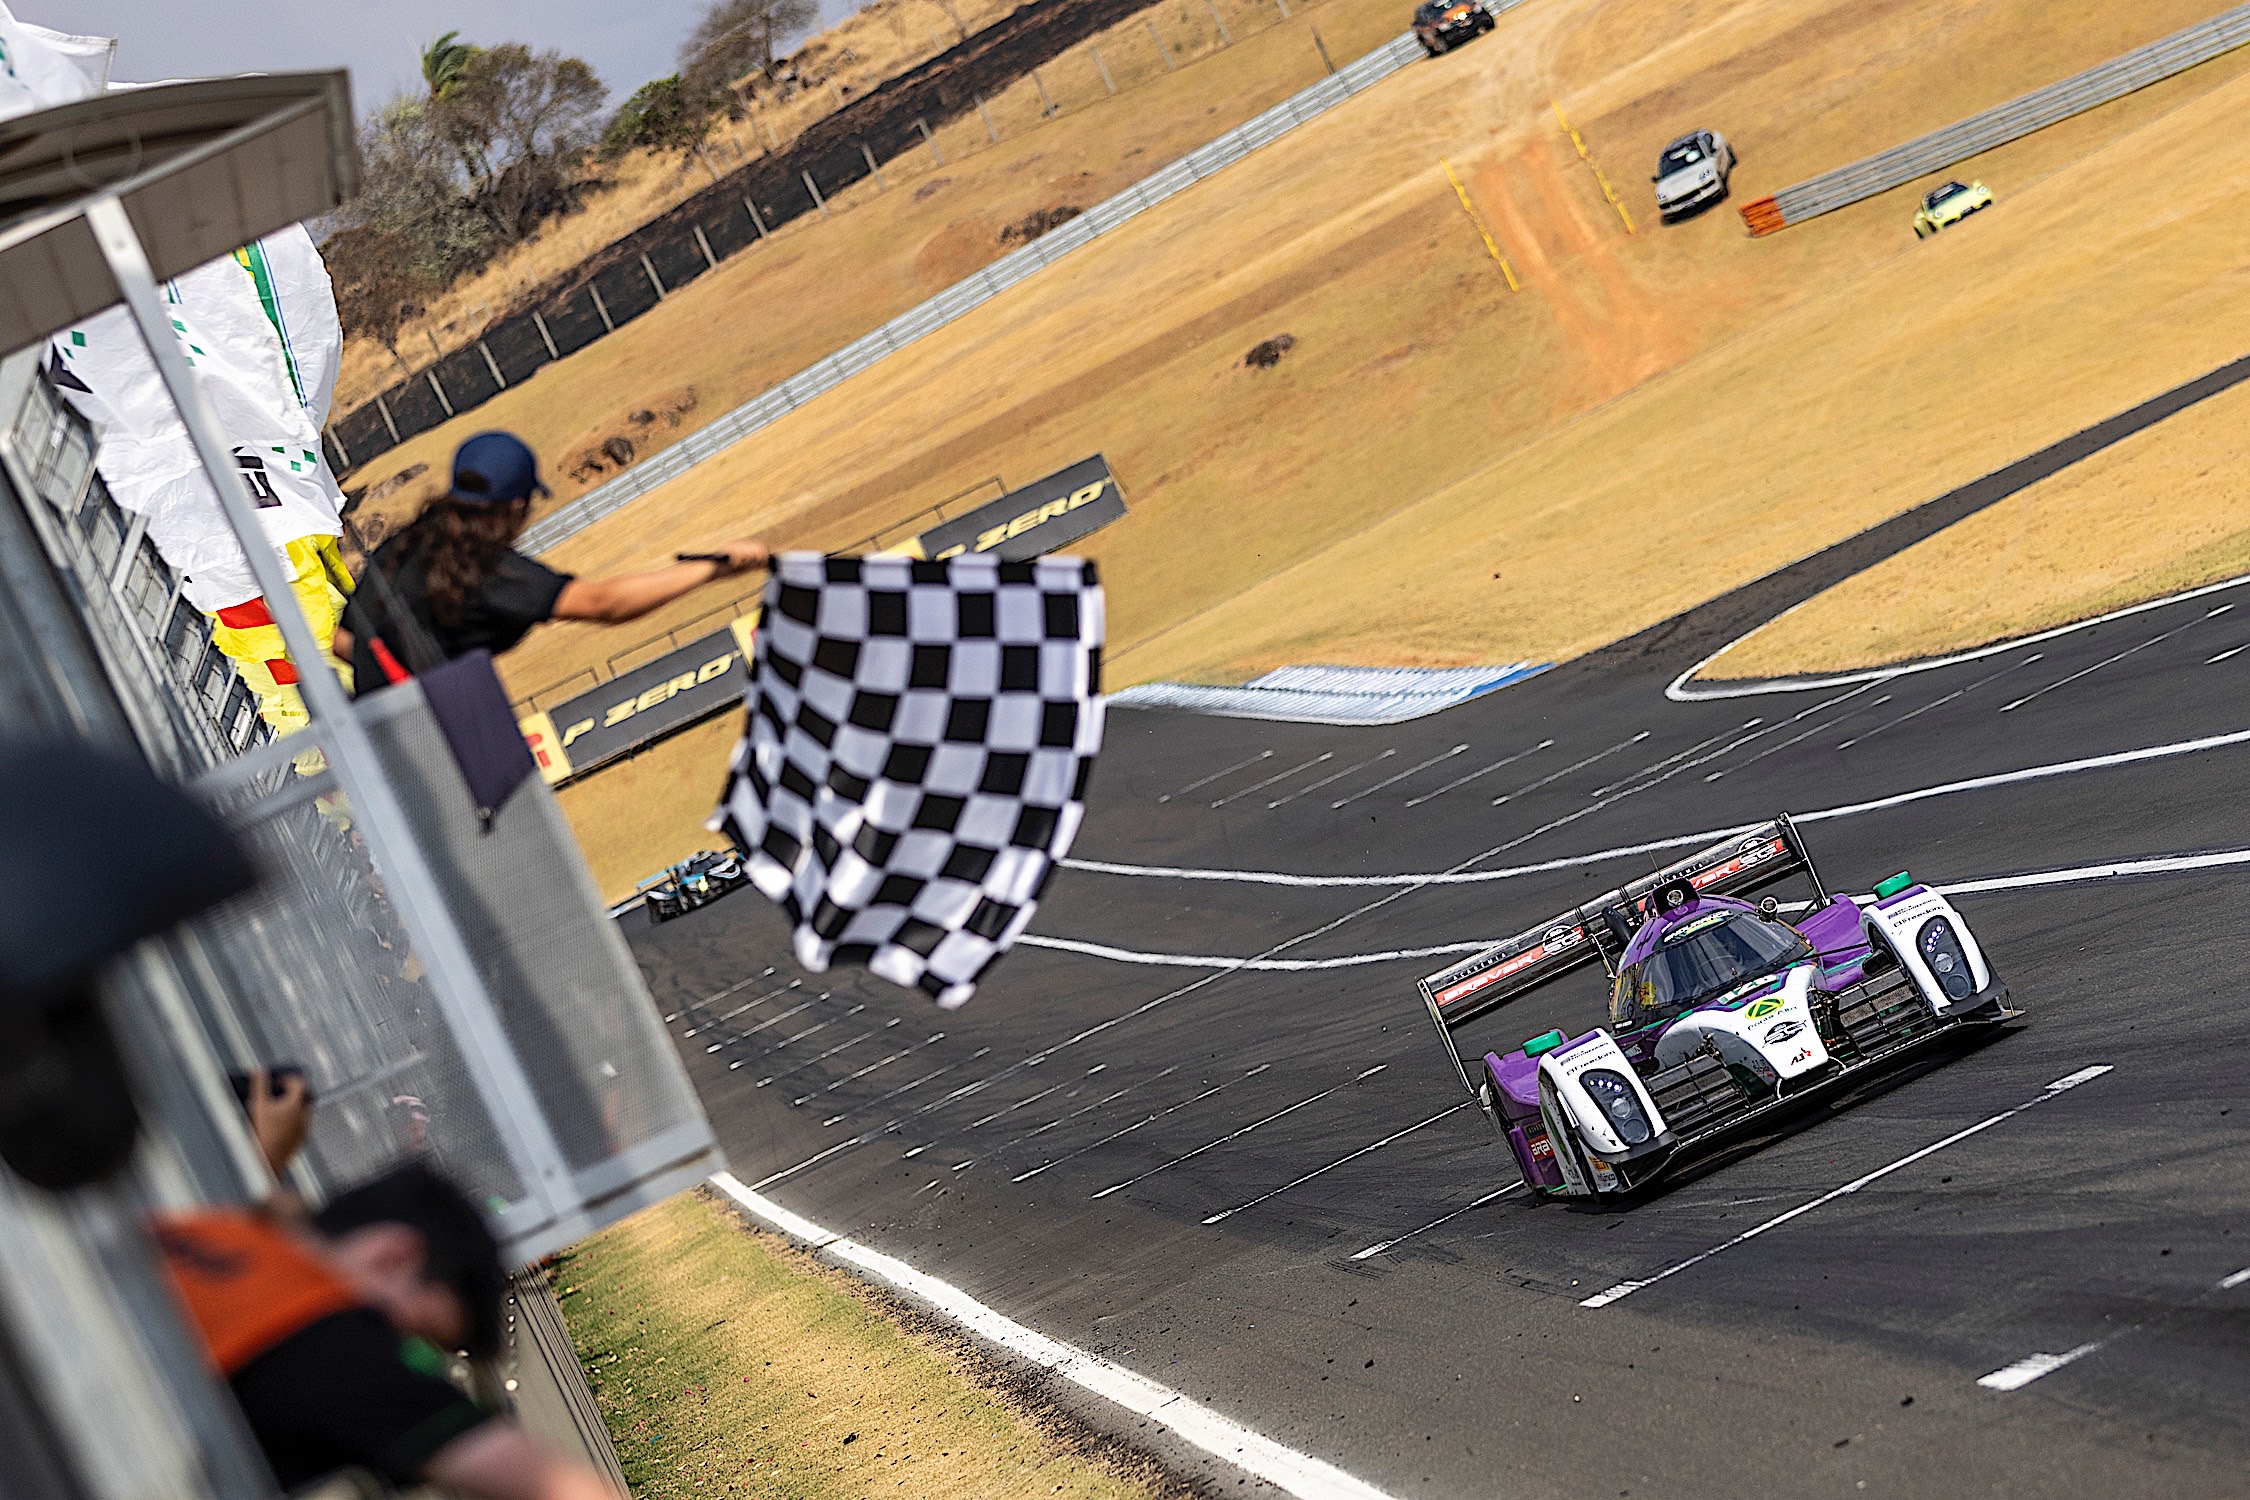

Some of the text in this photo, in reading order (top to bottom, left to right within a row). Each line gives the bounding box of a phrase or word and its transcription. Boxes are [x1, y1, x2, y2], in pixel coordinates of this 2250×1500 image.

[974, 480, 1105, 554] ZERO
[562, 653, 735, 748] P ZERO
[1453, 952, 1508, 981] ACADEMIA
[1574, 1050, 1616, 1071] Freedom
